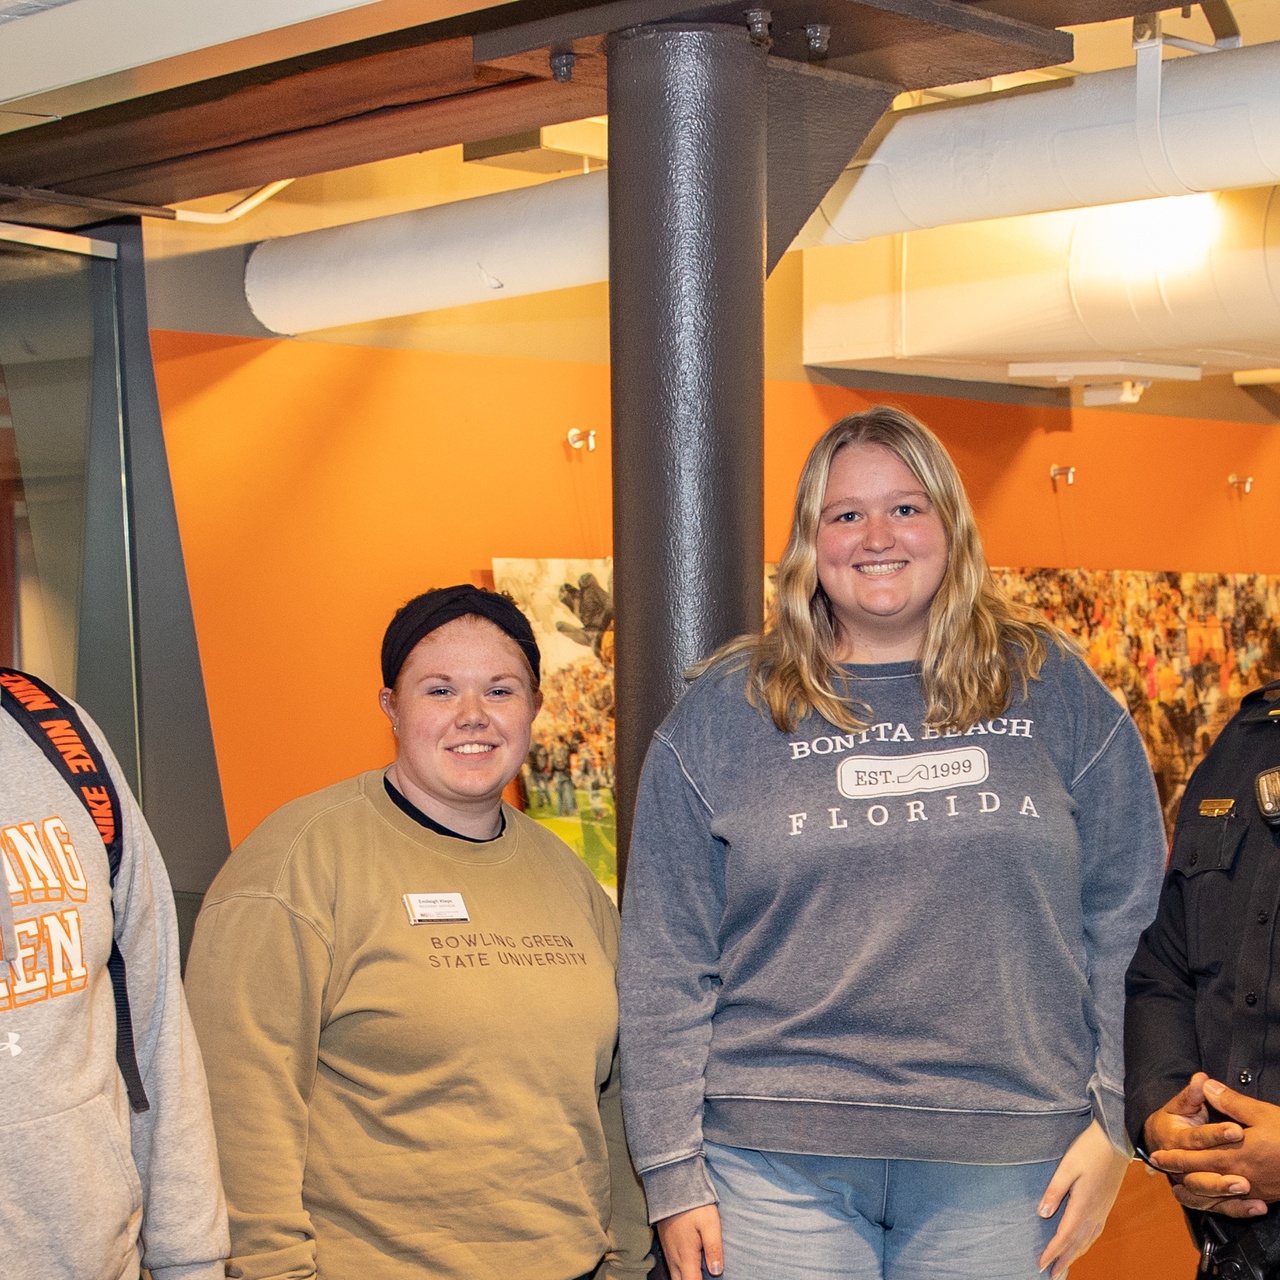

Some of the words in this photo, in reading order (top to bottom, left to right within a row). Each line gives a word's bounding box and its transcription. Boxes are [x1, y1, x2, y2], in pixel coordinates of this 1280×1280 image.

[39, 719, 98, 774] NIKE
[789, 722, 915, 760] BONITA
[854, 769, 895, 786] EST.
[930, 759, 972, 779] 1999
[80, 785, 115, 844] NIKE
[789, 791, 1040, 836] FLORIDA
[428, 952, 490, 968] STATE
[497, 951, 587, 967] UNIVERSITY
[430, 933, 517, 949] BOWLING
[521, 934, 574, 949] GREEN
